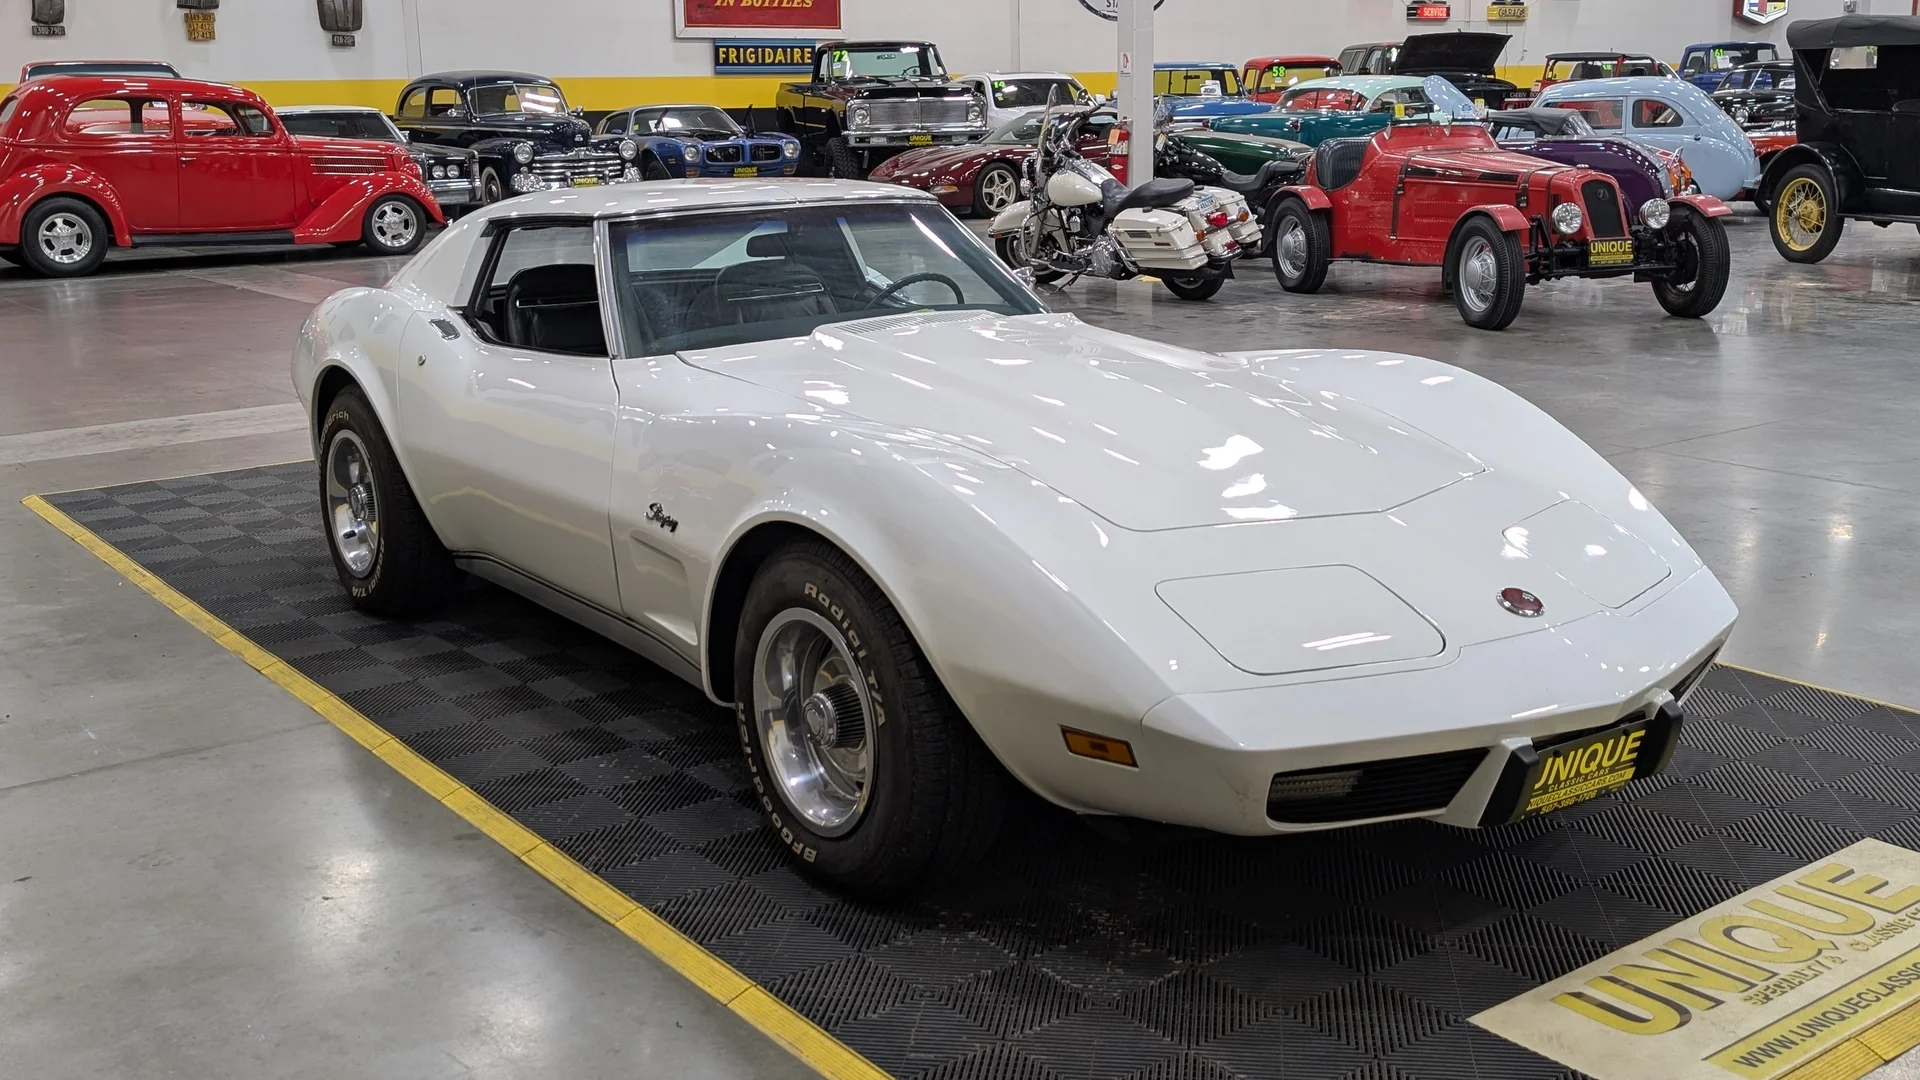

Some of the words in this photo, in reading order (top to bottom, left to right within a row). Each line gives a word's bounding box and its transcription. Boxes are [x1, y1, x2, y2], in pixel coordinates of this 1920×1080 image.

[719, 47, 812, 64] FRIGIDAIRE
[833, 50, 849, 62] 72
[1272, 66, 1286, 77] 58
[910, 134, 932, 142] UNIQUE
[734, 166, 758, 174] UNIQUE
[574, 177, 598, 185] UNIQUE
[1590, 240, 1633, 253] UNIQUE
[352, 586, 367, 598] T/A
[804, 582, 868, 659] Radial
[867, 669, 886, 727] T/A
[1548, 775, 1585, 792] CLASSIC
[1588, 767, 1610, 780] CARS
[1530, 770, 1627, 808] NIQUECLASSICCARS.COM
[1551, 862, 1920, 1036] UNIQUE
[1740, 959, 1833, 1006] SPECIALTY
